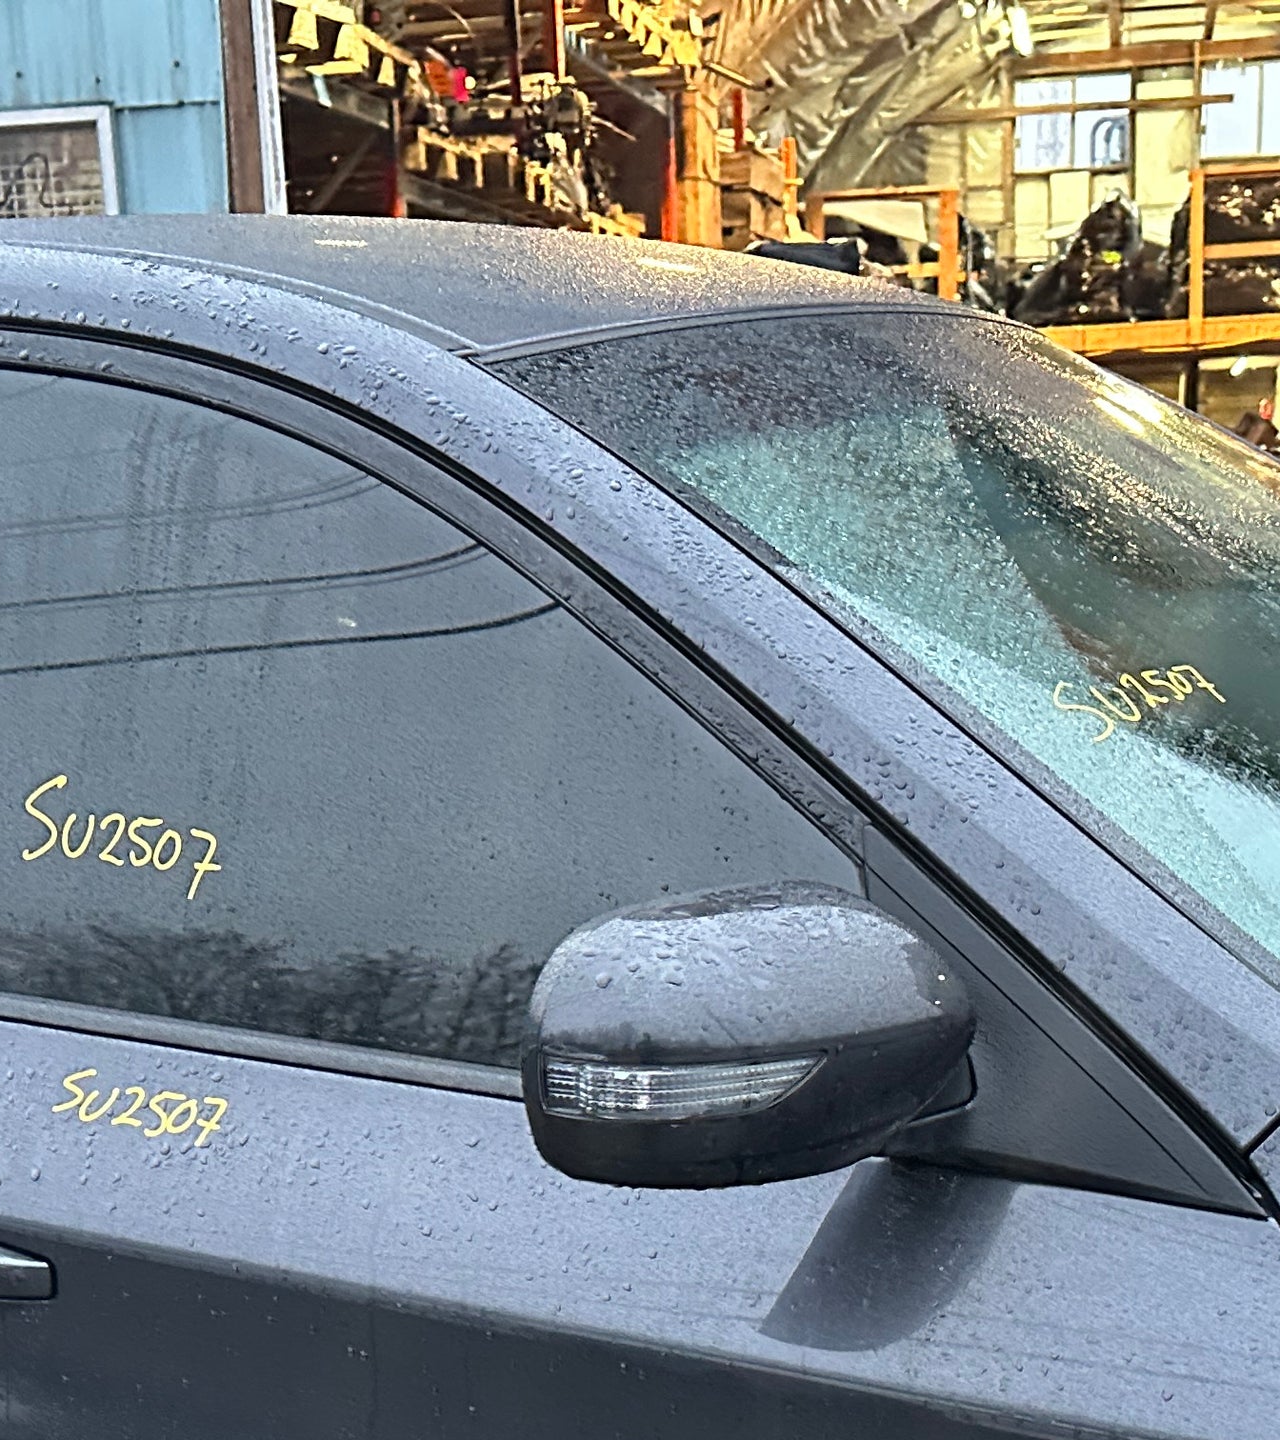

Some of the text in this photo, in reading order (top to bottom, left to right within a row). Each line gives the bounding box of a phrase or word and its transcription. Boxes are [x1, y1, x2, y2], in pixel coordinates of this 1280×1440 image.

[1052, 664, 1227, 744] SU2507
[21, 774, 223, 901] SU2507
[51, 1068, 229, 1147] SU2507
